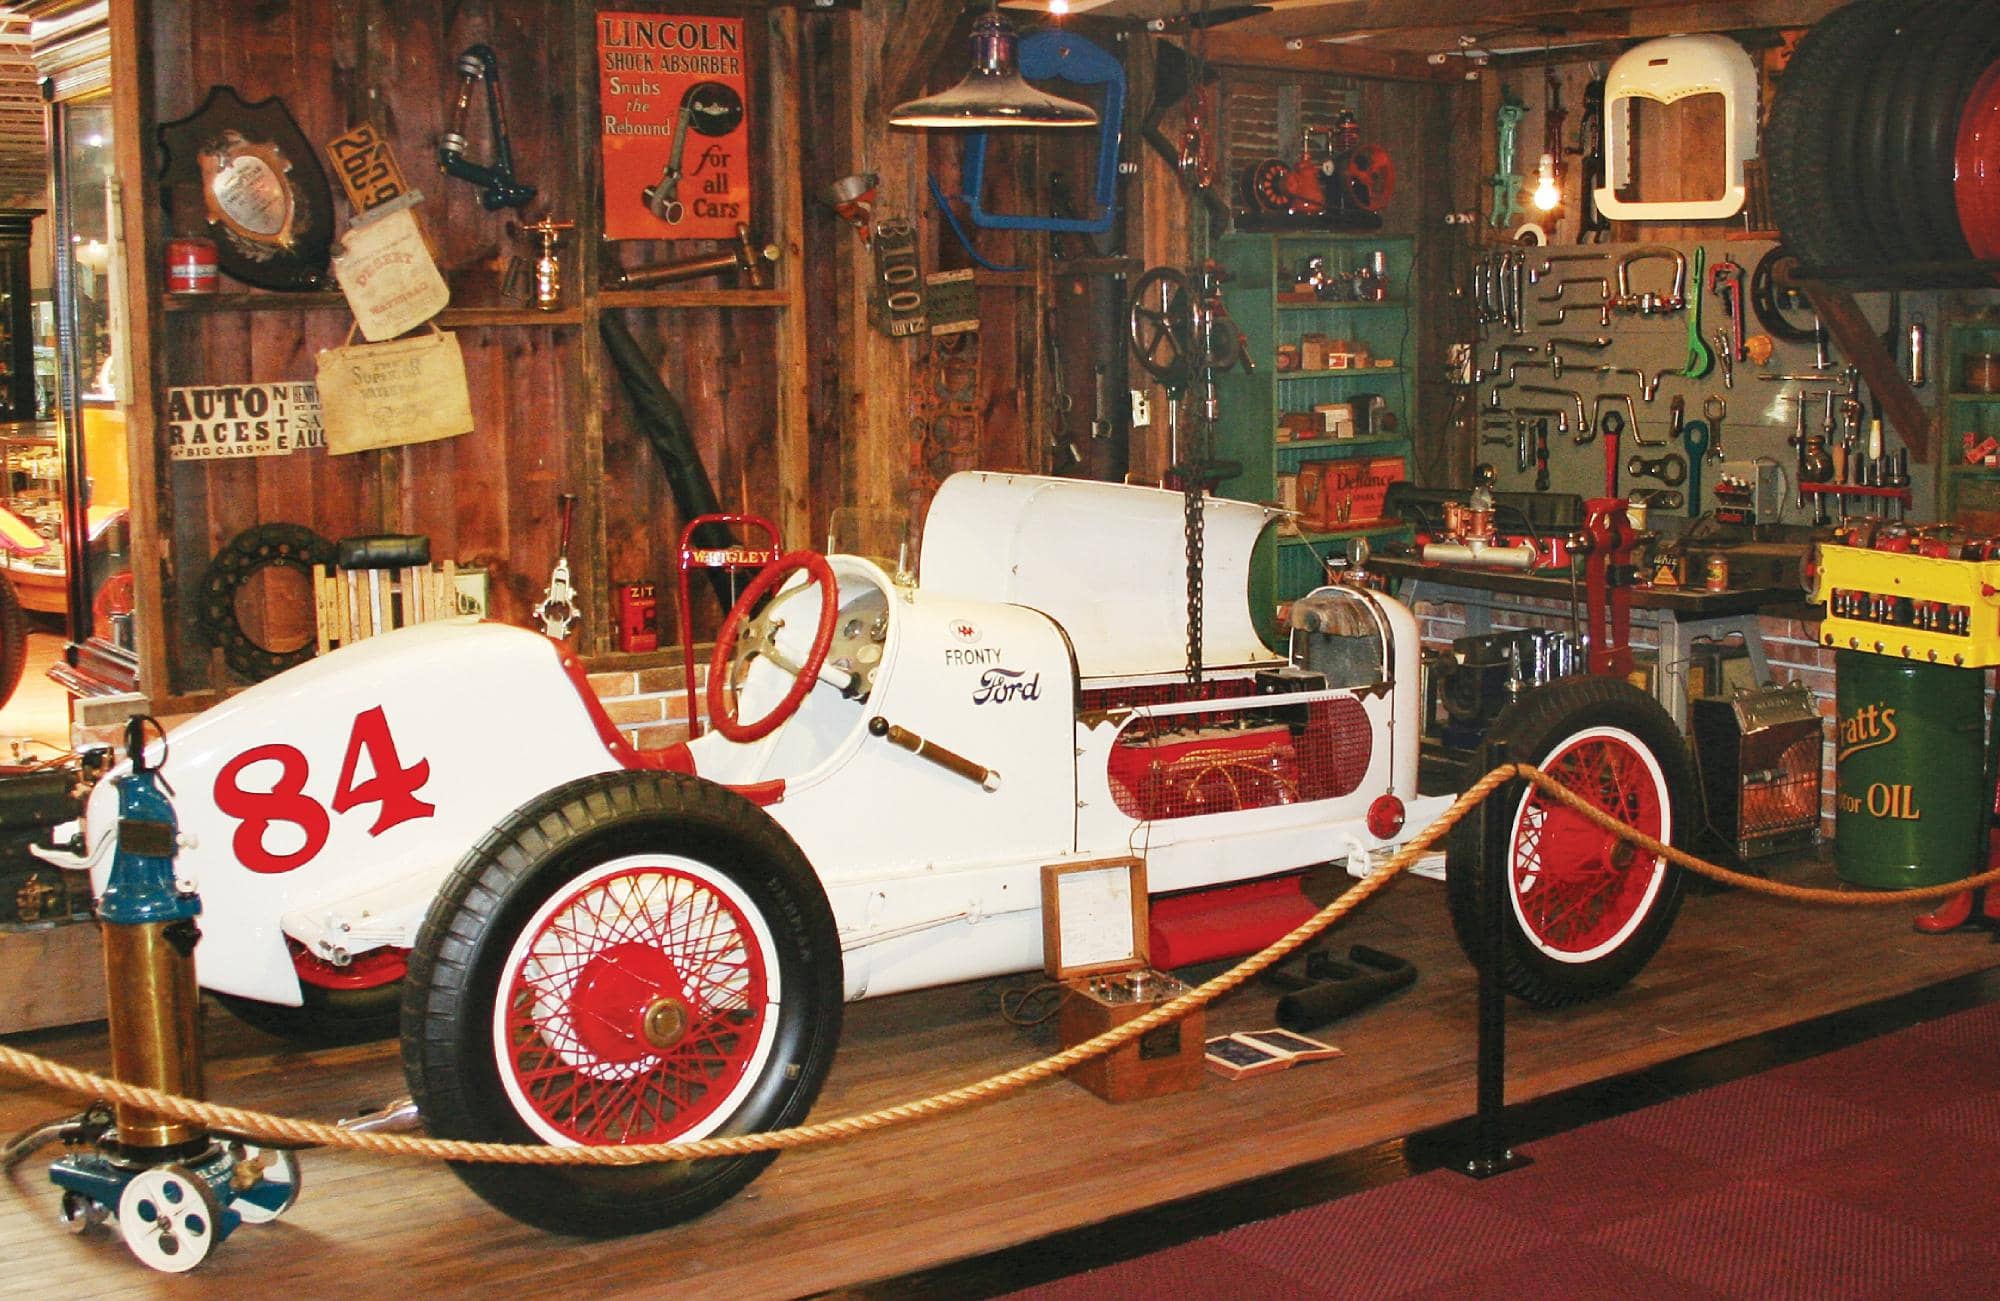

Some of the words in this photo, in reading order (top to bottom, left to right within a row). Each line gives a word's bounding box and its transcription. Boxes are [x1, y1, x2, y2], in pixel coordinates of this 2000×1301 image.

[602, 19, 739, 51] LINCOLN
[604, 52, 654, 73] SHOCK
[660, 54, 740, 75] ABSORBER
[609, 76, 661, 96] Snubs
[626, 99, 649, 113] the
[605, 115, 671, 136] Rebound
[691, 144, 731, 176] for
[704, 173, 729, 194] all
[692, 198, 740, 219] Cars
[168, 387, 269, 422] AUTO
[272, 386, 289, 450] NITE
[168, 421, 270, 446] RACES
[186, 446, 211, 457] BIG
[215, 445, 253, 456] CARS
[631, 586, 655, 598] ZIT
[945, 648, 1001, 666] FRONTY
[972, 667, 1042, 705] Ford
[1840, 701, 1898, 752] ratt's
[213, 704, 436, 875] 84
[1867, 782, 1921, 819] OIL
